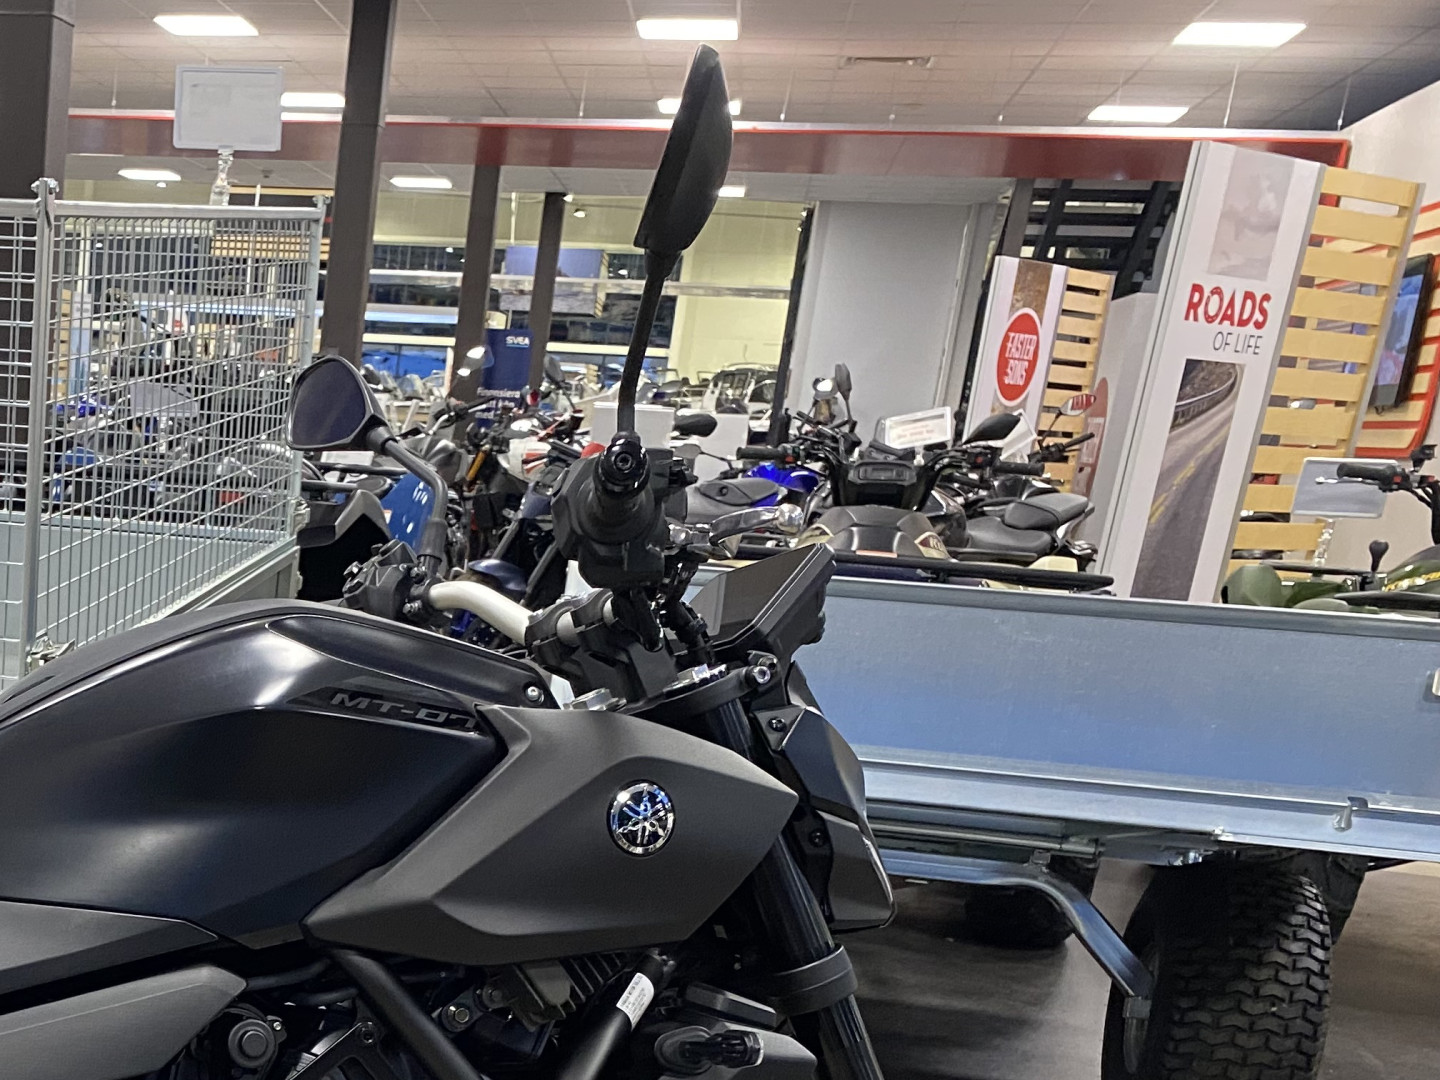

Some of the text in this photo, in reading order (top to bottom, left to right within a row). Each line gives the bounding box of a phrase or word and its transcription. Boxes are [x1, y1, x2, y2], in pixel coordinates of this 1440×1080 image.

[1184, 282, 1272, 330] ROADS
[505, 335, 530, 345] SVEA
[1005, 331, 1038, 360] FASTER
[1213, 331, 1263, 355] OF LIFE
[1003, 359, 1029, 386] SONS
[330, 692, 480, 728] MT-07
